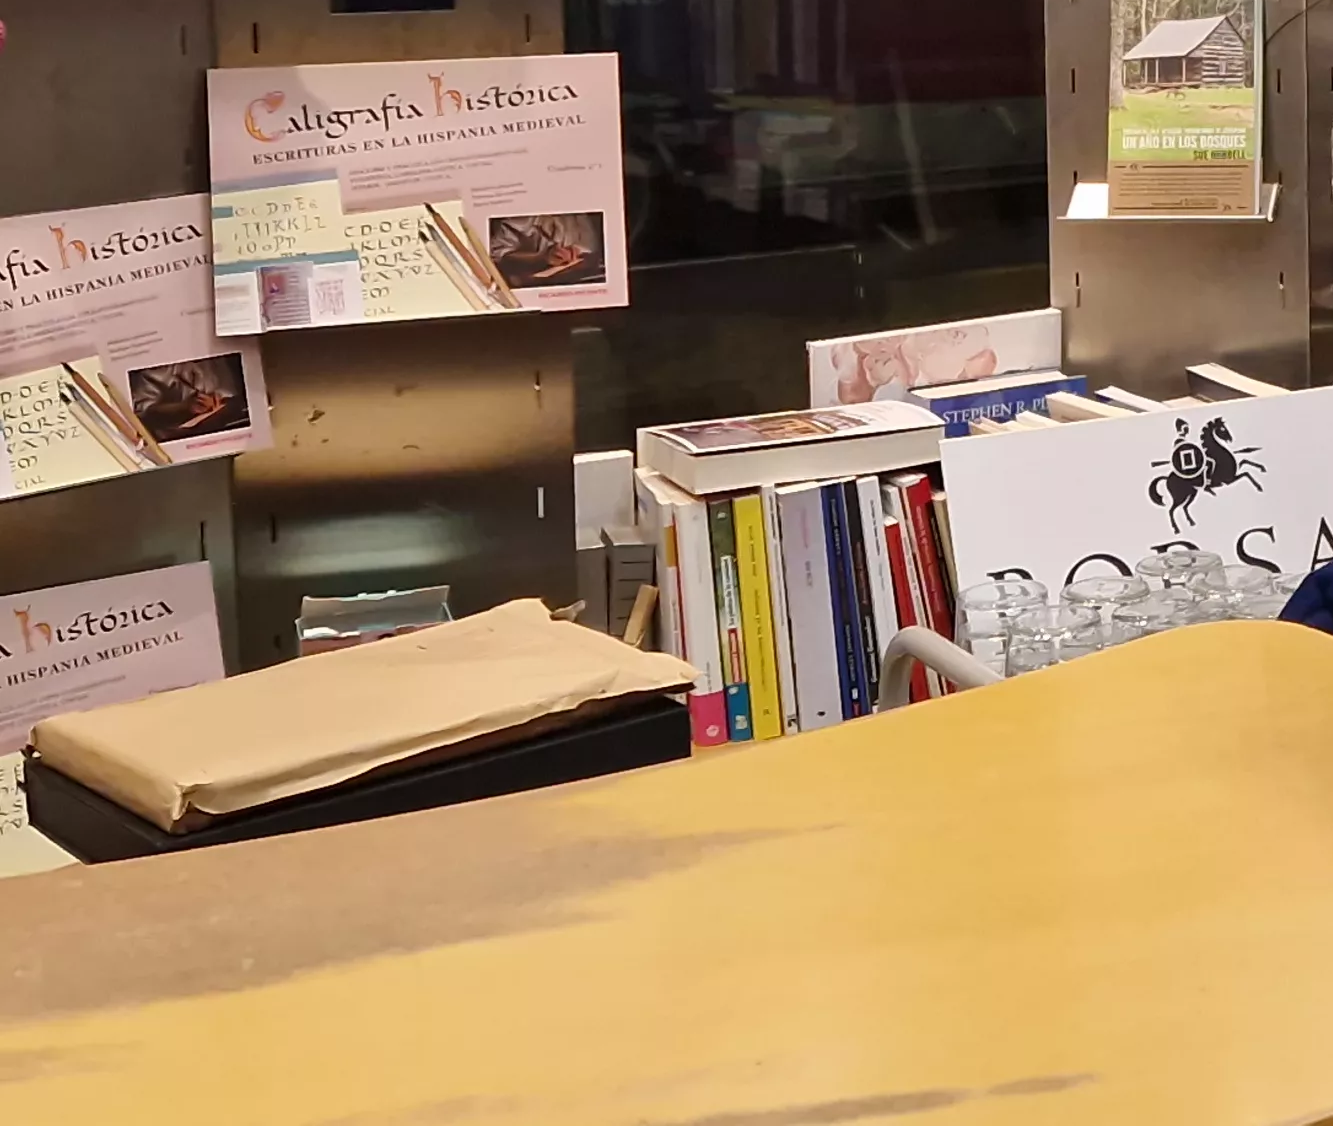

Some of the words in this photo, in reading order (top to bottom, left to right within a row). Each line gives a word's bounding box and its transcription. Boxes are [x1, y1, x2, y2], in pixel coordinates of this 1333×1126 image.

[244, 90, 424, 144] Caligrafía
[252, 143, 358, 166] ESCRITURAS
[363, 138, 386, 152] EN
[391, 135, 413, 149] LA
[417, 126, 498, 145] HISPANIA
[502, 114, 587, 135] MEDIEVAL
[1122, 135, 1137, 149] UN
[1162, 134, 1176, 149] EN
[1178, 134, 1197, 148] LOS
[1200, 134, 1247, 149] BOSQUES
[20, 293, 42, 307] LA
[46, 275, 126, 302] HISPANIA
[130, 252, 213, 283] MEDIEVAL
[942, 402, 1012, 426] STEPHEN
[6, 654, 93, 688] HISPANIA
[96, 630, 185, 663] MEDIEVAL
